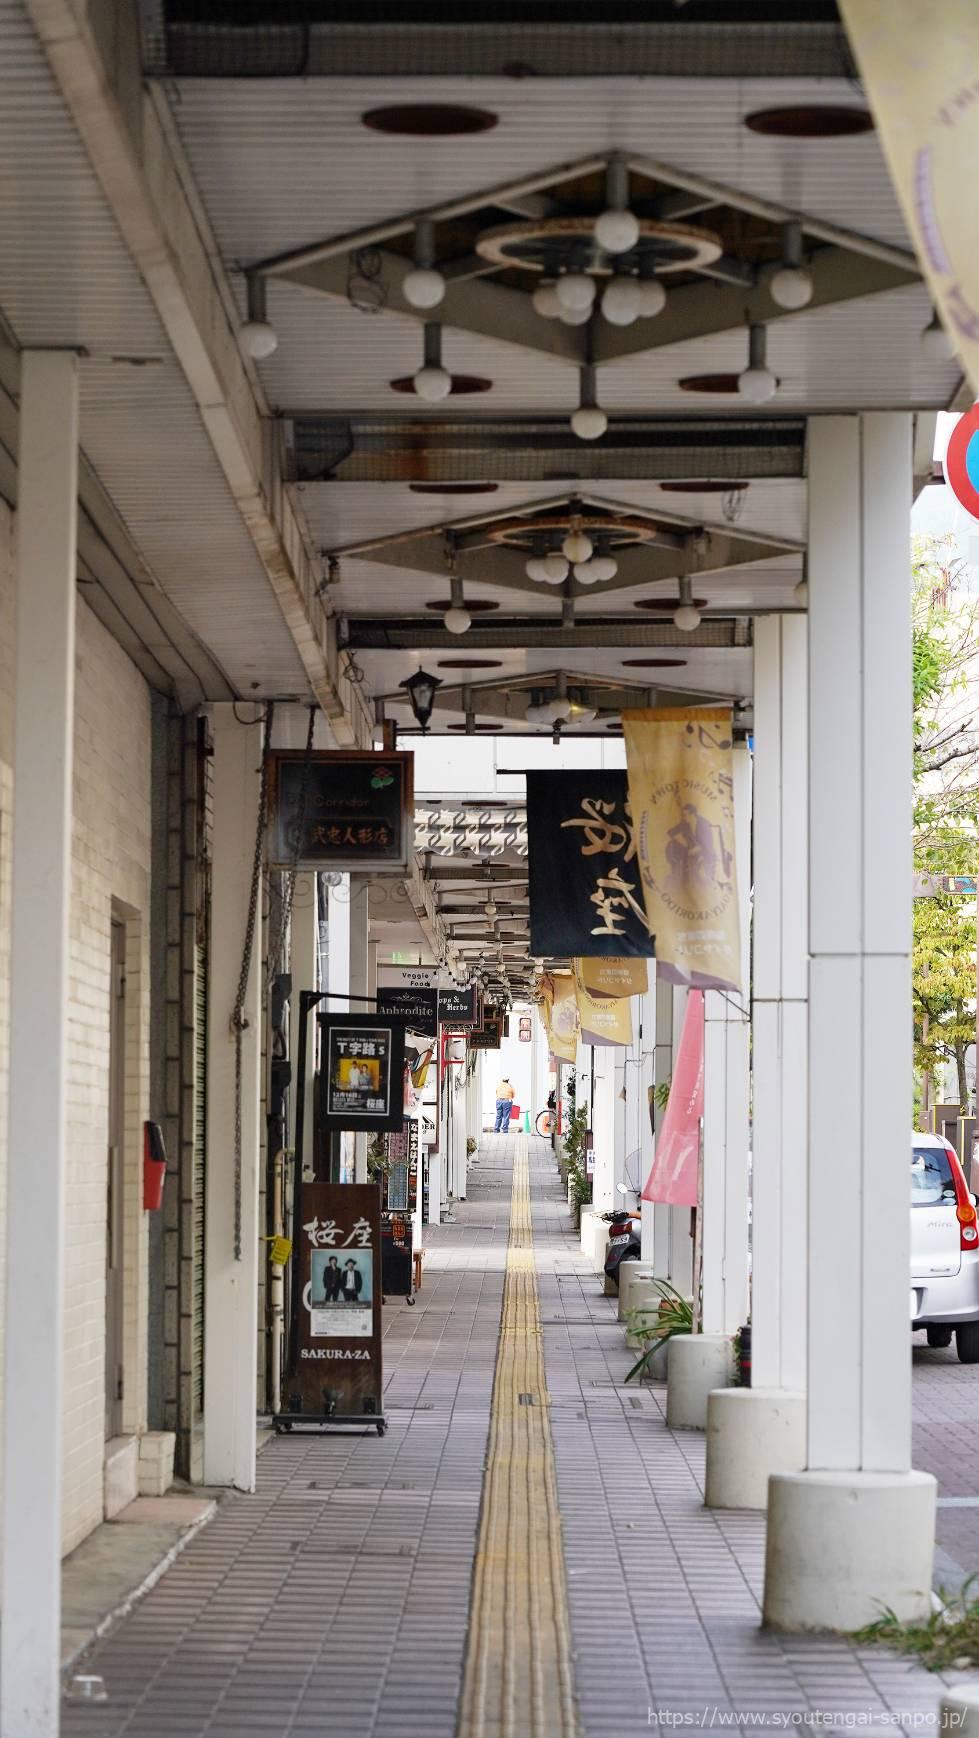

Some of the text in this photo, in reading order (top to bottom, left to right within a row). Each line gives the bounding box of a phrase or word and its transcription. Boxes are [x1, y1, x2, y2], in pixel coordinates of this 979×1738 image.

[402, 972, 429, 980] Veggie
[453, 995, 460, 1003] &
[302, 1216, 373, 1248] 桜座
